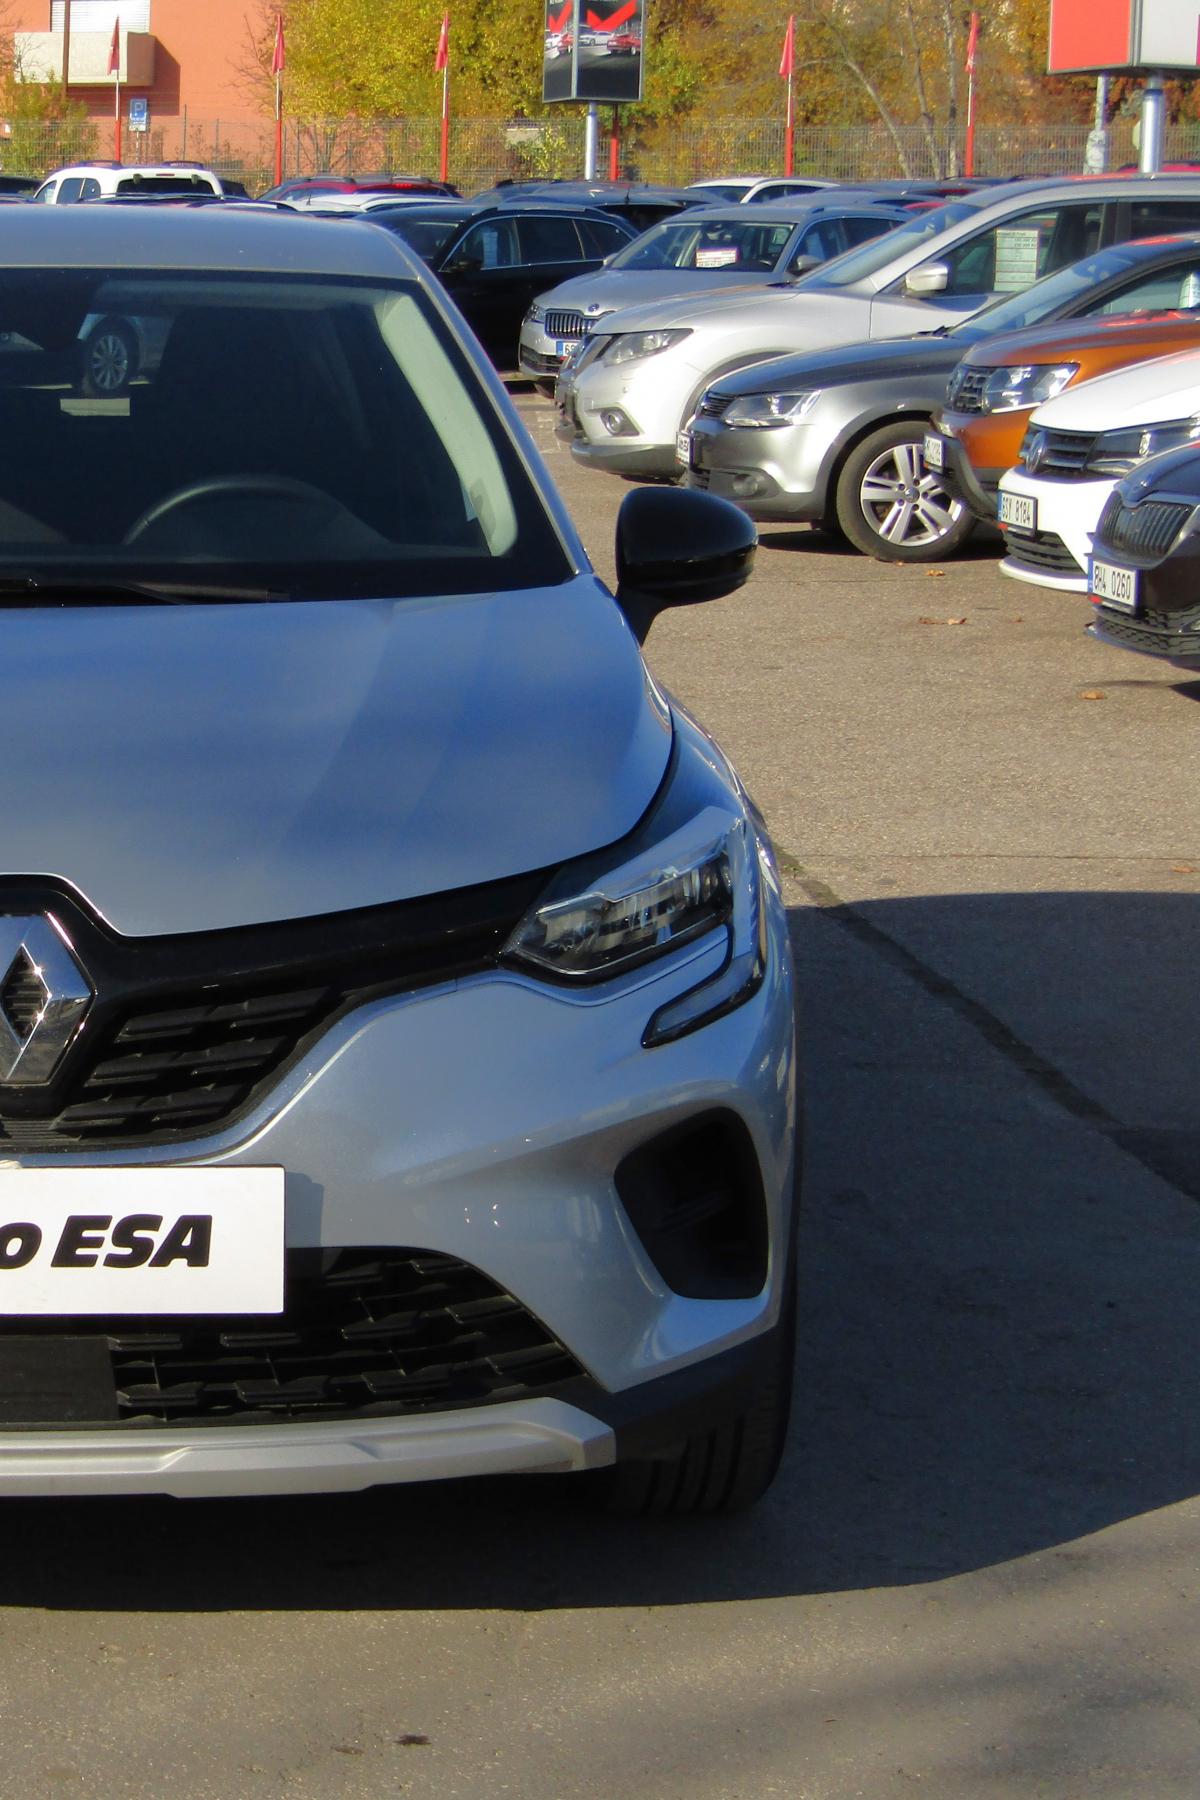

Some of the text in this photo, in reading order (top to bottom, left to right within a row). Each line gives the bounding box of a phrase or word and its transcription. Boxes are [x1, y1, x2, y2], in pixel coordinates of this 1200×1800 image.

[1094, 565, 1131, 600] 8H4 0260
[50, 1213, 213, 1269] ESA
